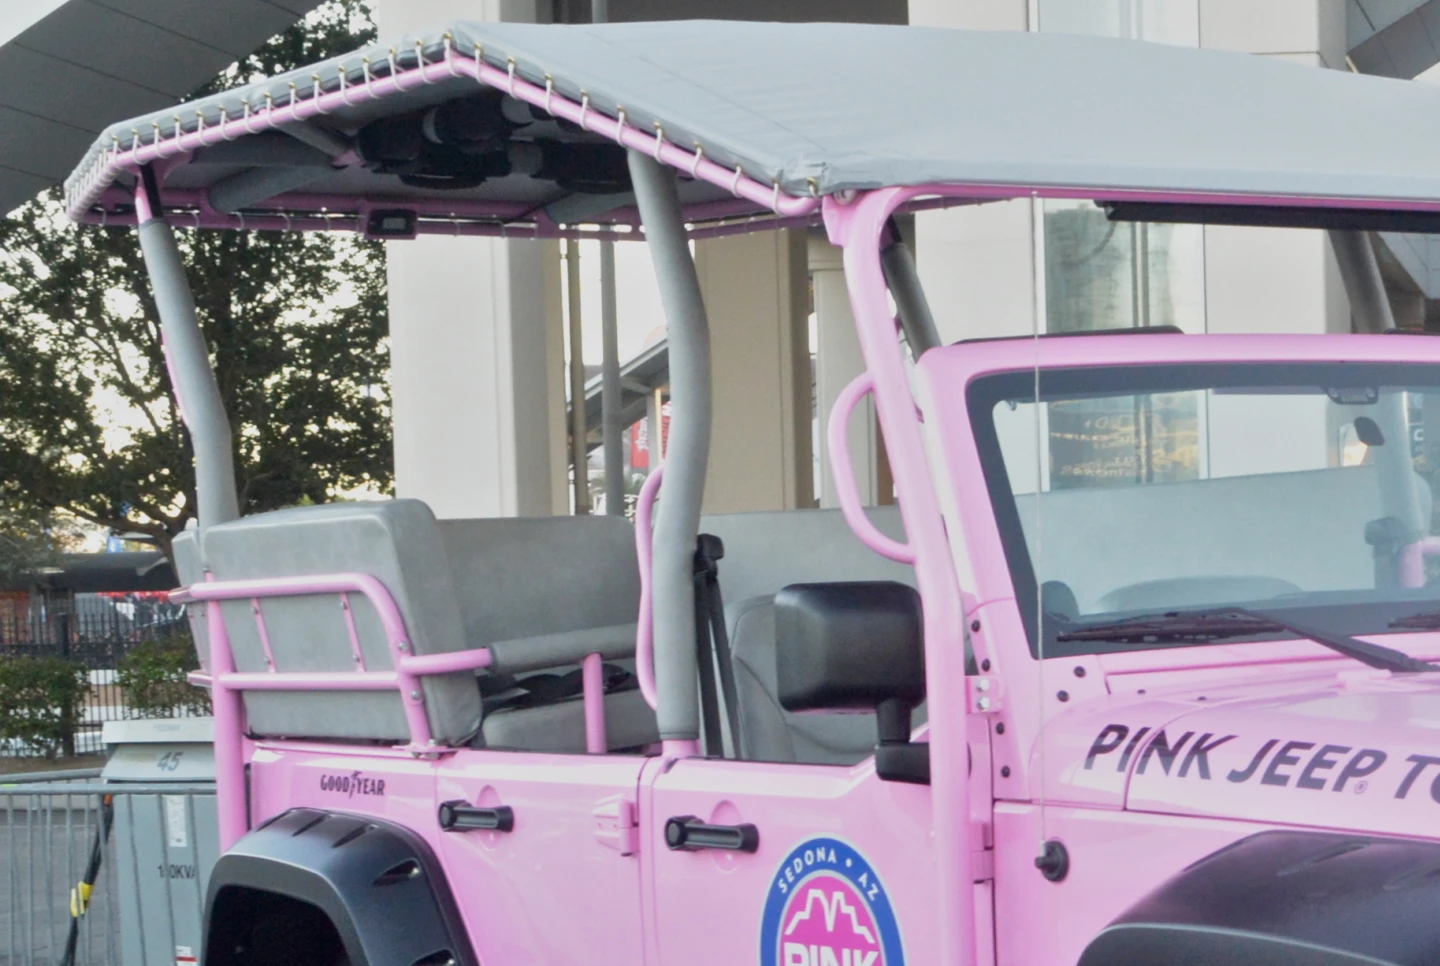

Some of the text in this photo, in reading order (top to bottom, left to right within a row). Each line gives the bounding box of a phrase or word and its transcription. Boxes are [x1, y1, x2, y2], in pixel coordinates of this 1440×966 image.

[1083, 724, 1238, 779] PINK
[778, 846, 880, 902] SEDONA AZ
